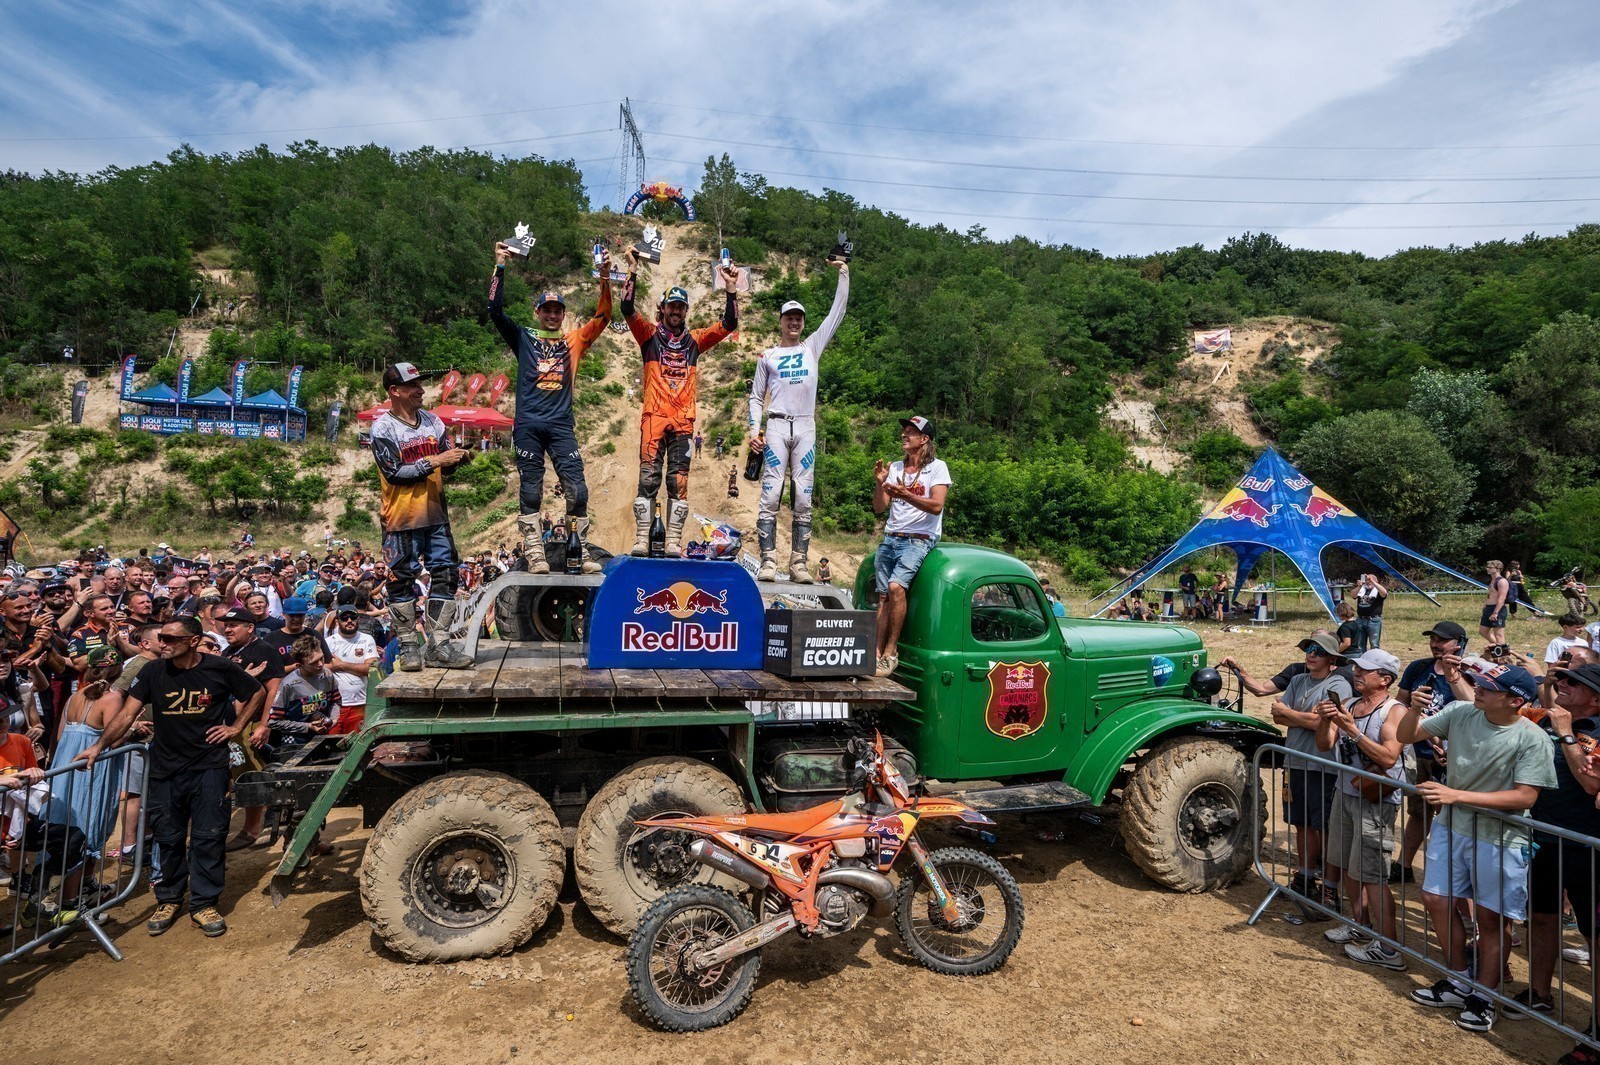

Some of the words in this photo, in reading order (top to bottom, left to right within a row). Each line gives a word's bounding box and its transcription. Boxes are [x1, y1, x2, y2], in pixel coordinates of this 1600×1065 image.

[522, 235, 537, 247] 20
[651, 238, 666, 250] 20
[844, 242, 853, 250] 20
[126, 358, 136, 379] MOLY
[777, 353, 803, 370] 23
[182, 362, 192, 381] MOLY
[236, 363, 246, 384] MOLY
[292, 368, 302, 386] MOLY
[662, 368, 687, 378] KTM
[780, 369, 809, 379] BULGARIA
[124, 379, 133, 399] LIQUI
[181, 381, 190, 402] LIQUI
[290, 386, 298, 407] LIQUI
[1241, 476, 1274, 491] Bull
[1284, 474, 1311, 490] Red
[768, 624, 788, 634] DELIVERY
[816, 620, 854, 628] DELIVERY
[622, 622, 681, 652] Red
[682, 622, 738, 652] Bull
[805, 637, 842, 647] POWERED
[844, 637, 855, 647] BY
[767, 646, 788, 658] ECONT
[803, 649, 866, 666] ECONT
[1005, 679, 1020, 689] Red
[1020, 679, 1034, 689] Bull
[1510, 686, 1524, 696] RACING
[750, 843, 757, 854] 6
[929, 873, 947, 900] MOTOREX
